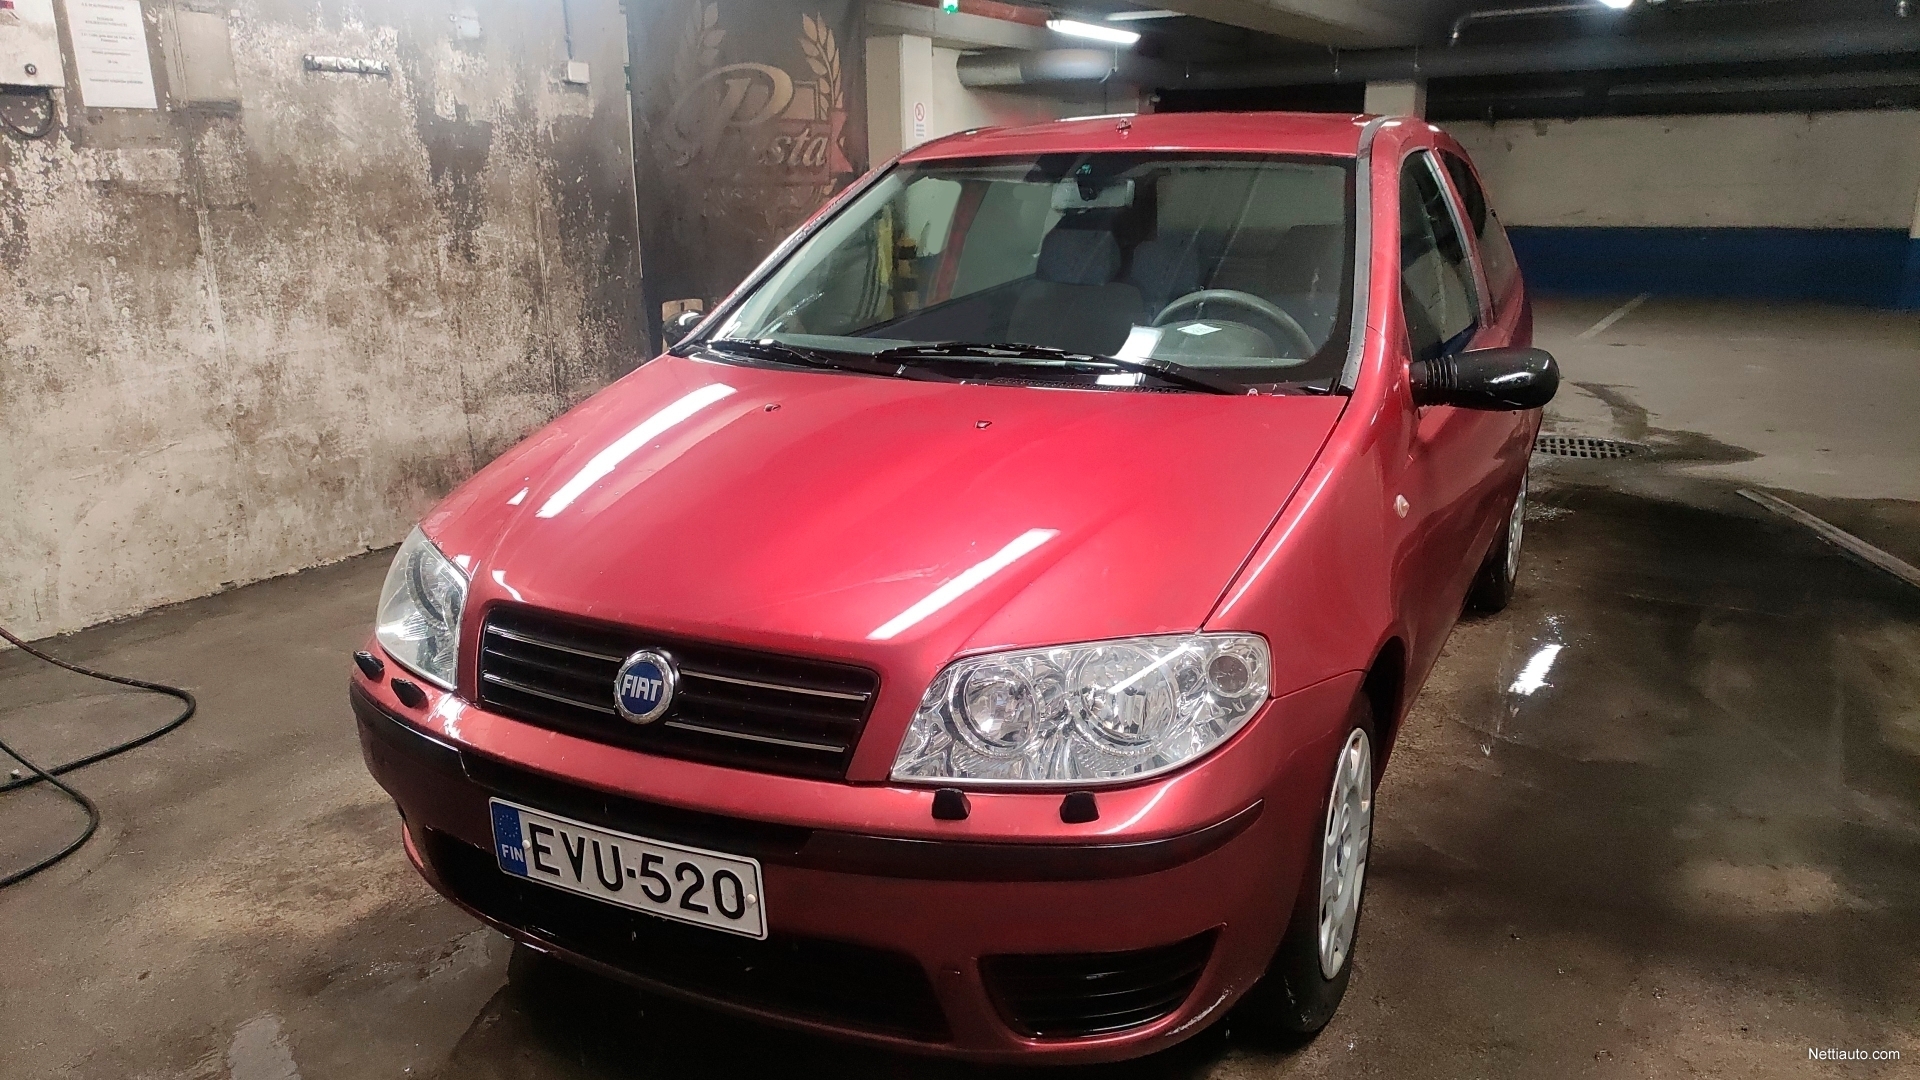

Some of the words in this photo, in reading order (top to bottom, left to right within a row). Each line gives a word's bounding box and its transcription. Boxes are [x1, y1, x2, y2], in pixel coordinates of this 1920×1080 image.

[653, 62, 829, 167] Psta
[621, 674, 662, 702] FIAT
[502, 844, 525, 863] FIN
[528, 823, 746, 920] EVU-520
